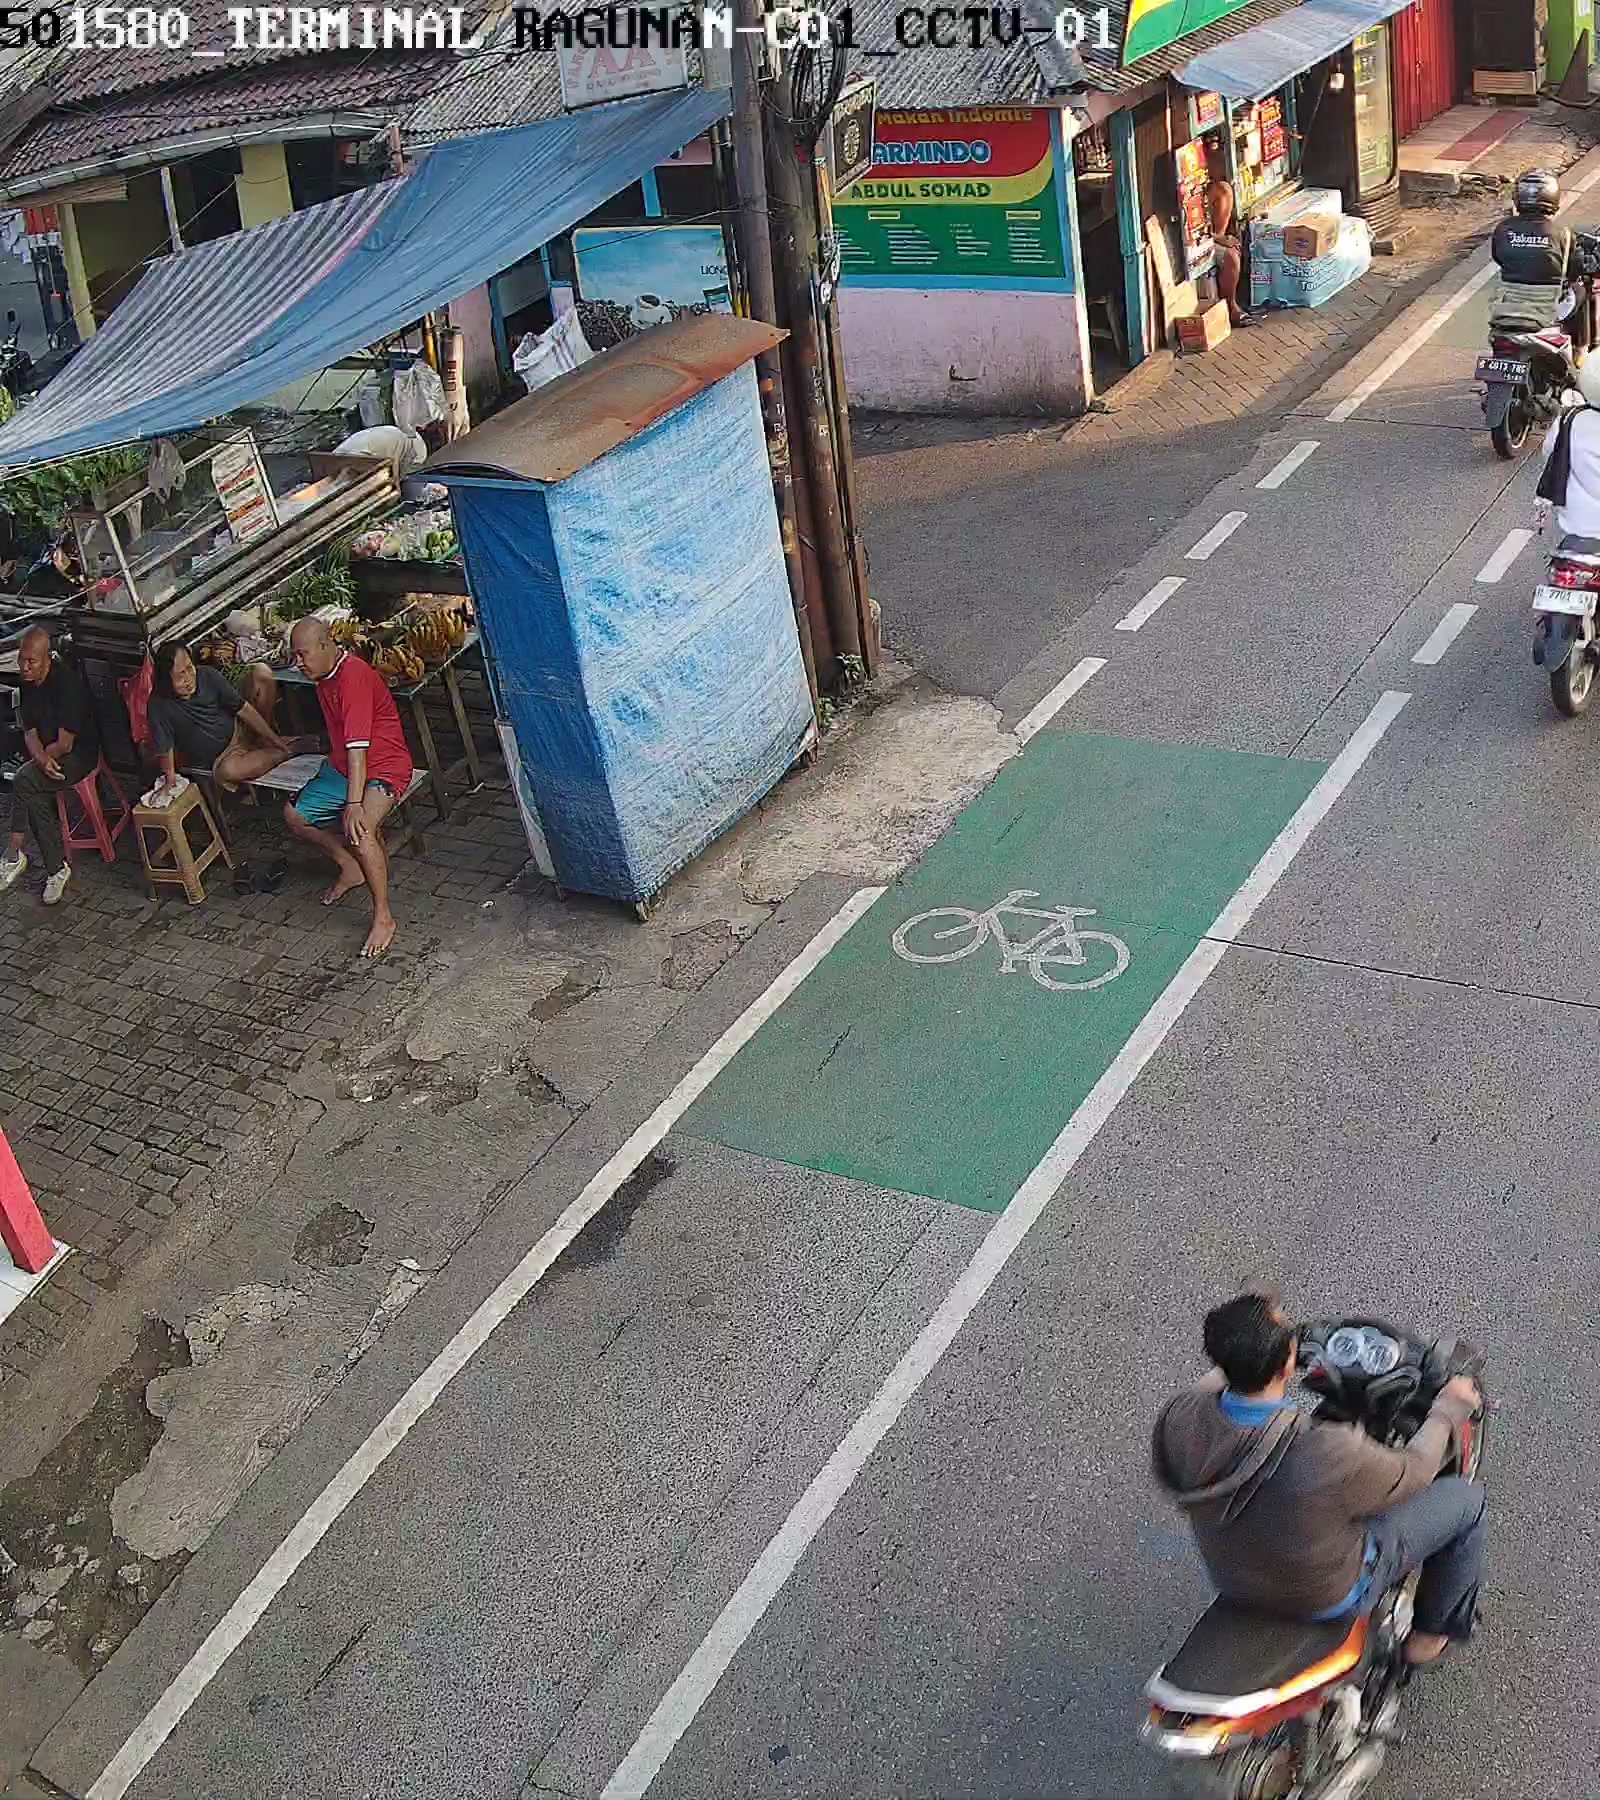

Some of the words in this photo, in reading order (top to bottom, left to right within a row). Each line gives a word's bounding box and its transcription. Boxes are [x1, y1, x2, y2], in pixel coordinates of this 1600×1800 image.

[871, 139, 992, 166] ARMINDO
[851, 183, 917, 198] ABDUL
[919, 182, 992, 198] SOMAD
